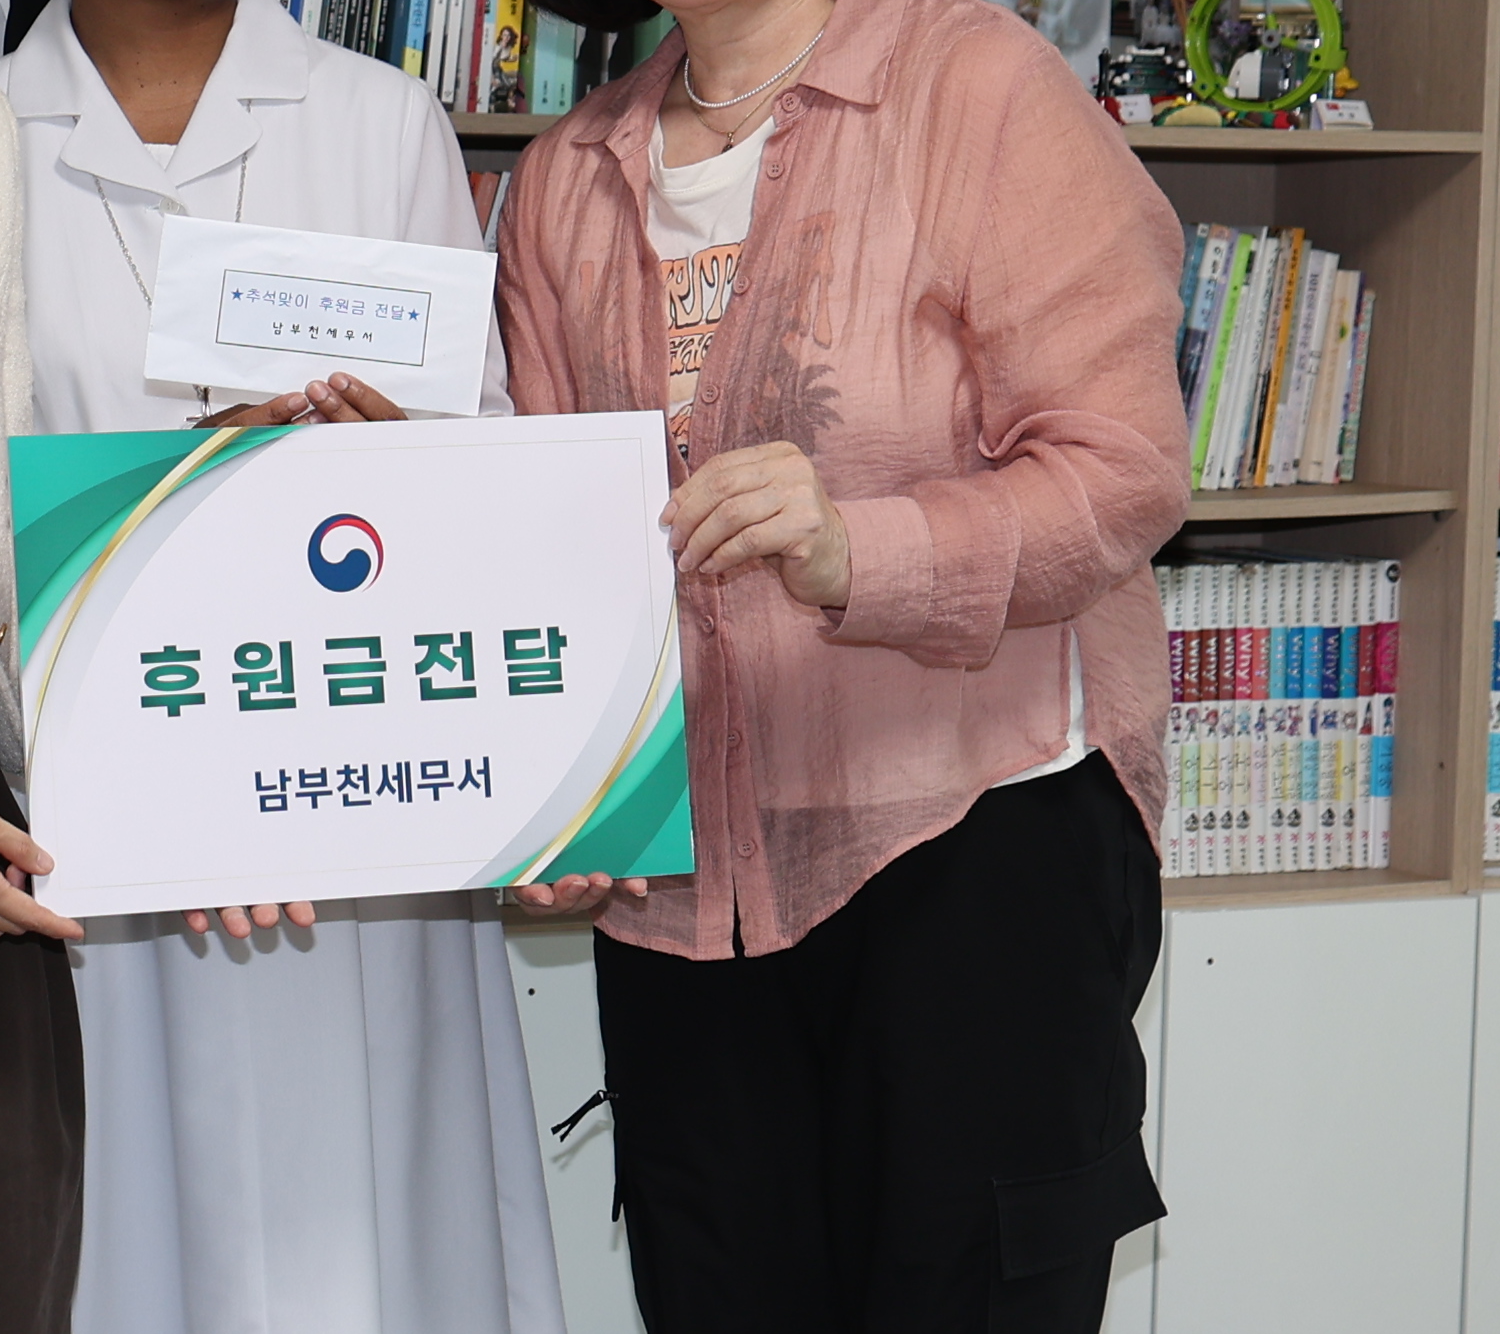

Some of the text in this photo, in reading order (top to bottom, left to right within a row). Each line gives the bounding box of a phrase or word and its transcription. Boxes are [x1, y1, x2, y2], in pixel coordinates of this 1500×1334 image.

[245, 286, 406, 325] 추석맞이 후원금 전달
[271, 320, 375, 345] 남부천세무서
[139, 625, 570, 718] 후원금전달
[253, 757, 493, 813] 남부천세무서
